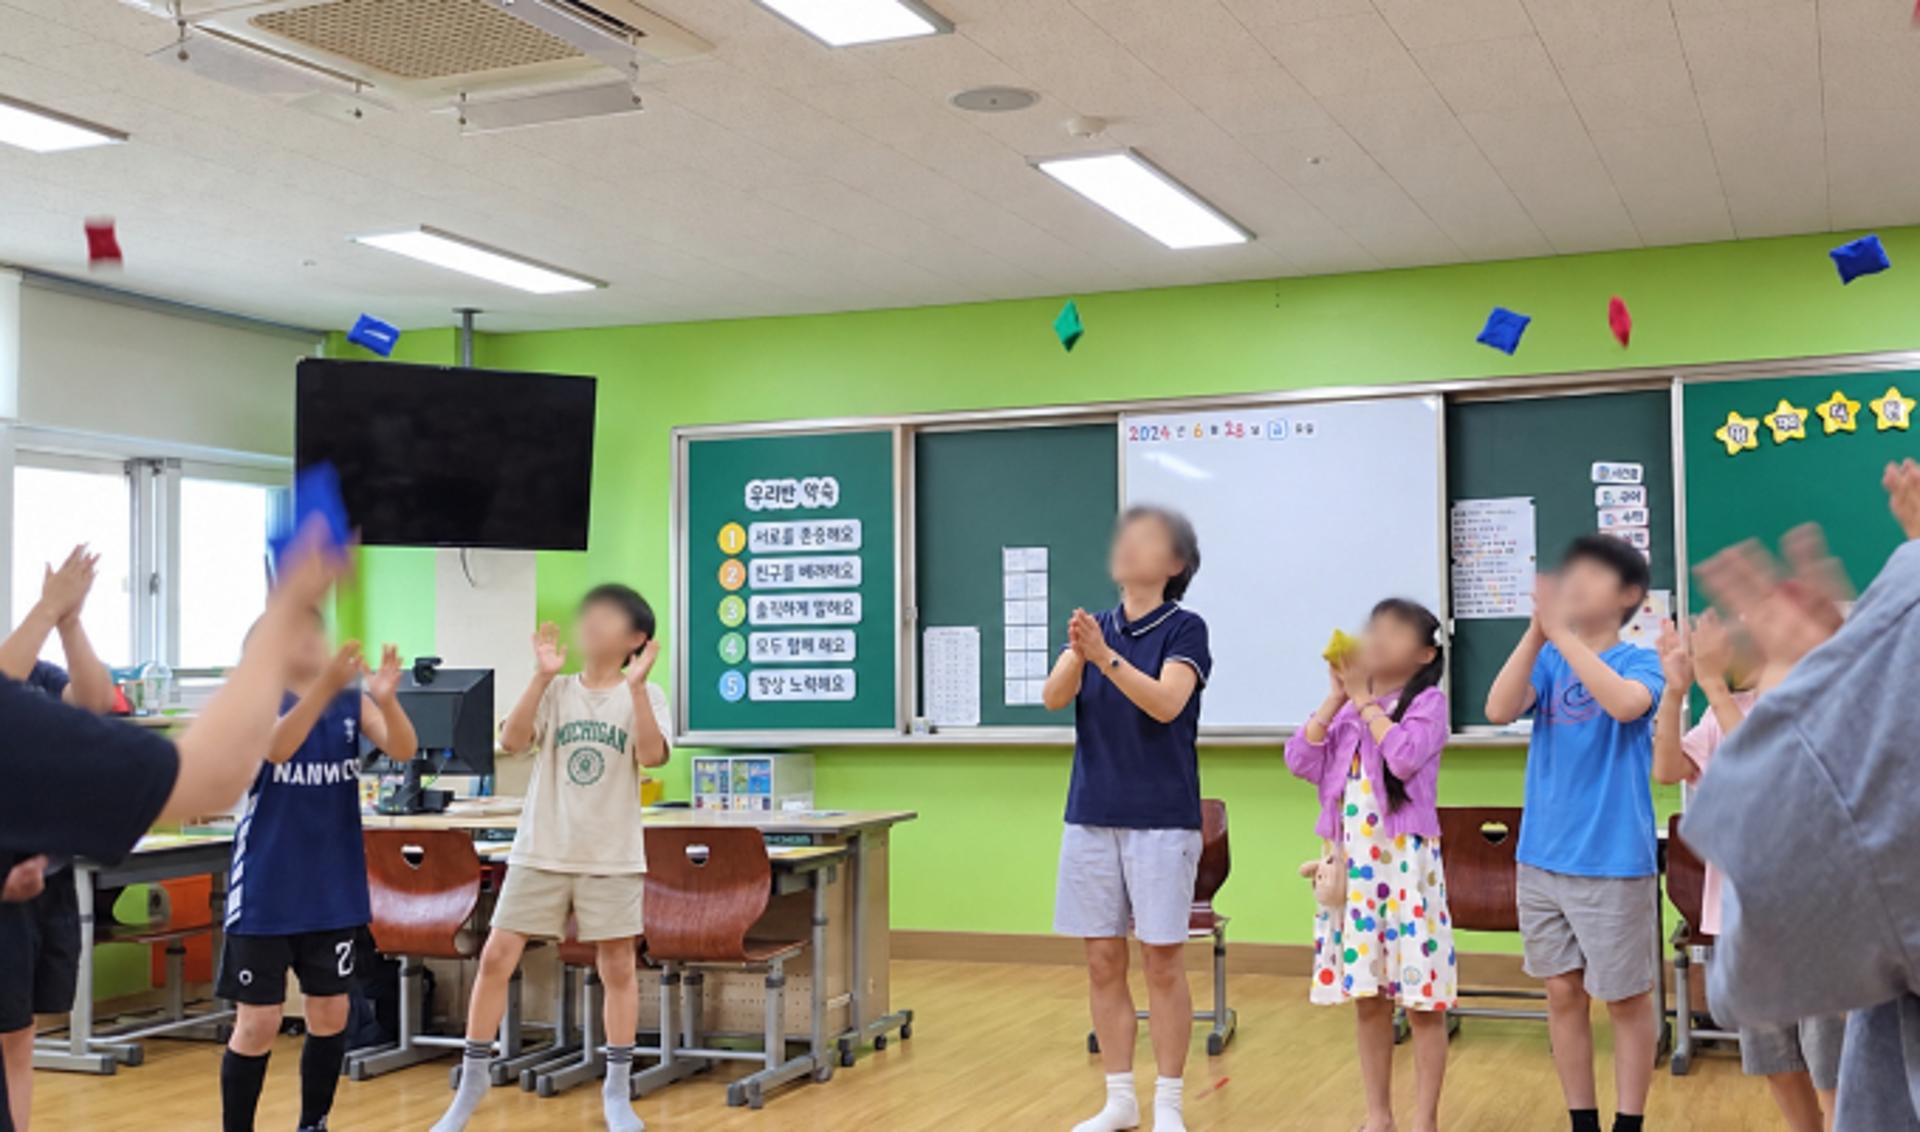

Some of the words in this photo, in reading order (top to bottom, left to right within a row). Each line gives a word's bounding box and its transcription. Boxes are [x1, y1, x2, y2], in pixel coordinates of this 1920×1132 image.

[1128, 425, 1171, 441] 2024
[1193, 423, 1203, 438] 6
[750, 484, 797, 506] 우리반
[803, 481, 834, 502] 약속
[754, 527, 794, 546] 서로를
[801, 525, 853, 546] 존중해요
[756, 564, 794, 583] 친구를
[799, 562, 853, 580] 배려해요
[756, 600, 809, 620] 솔직하게
[813, 598, 854, 619] 말해요
[756, 637, 782, 656] 모두
[787, 637, 815, 656] 함께
[818, 637, 846, 654] 해요
[757, 676, 786, 696] 항상
[790, 674, 845, 694] 노력해요
[555, 720, 628, 755] MICHIGAN
